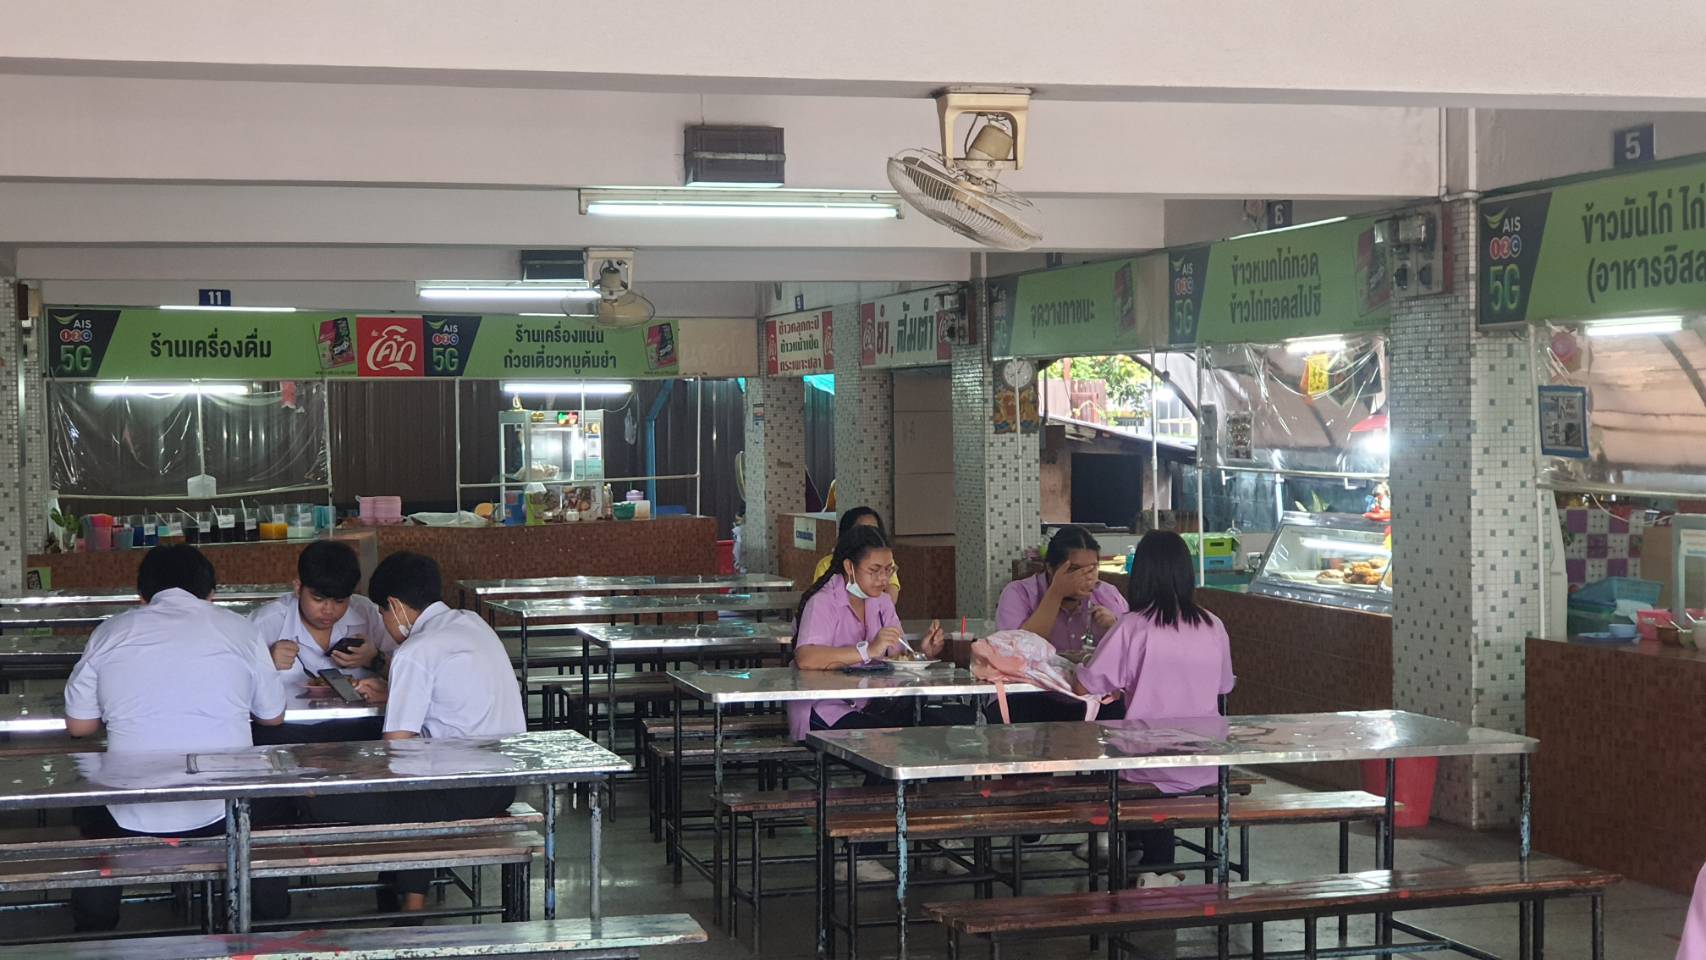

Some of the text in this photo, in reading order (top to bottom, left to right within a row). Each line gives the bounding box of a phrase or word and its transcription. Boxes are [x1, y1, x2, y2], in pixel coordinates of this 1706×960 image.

[1624, 131, 1641, 160] 5
[1274, 204, 1284, 225] 6
[1502, 216, 1521, 233] AIS
[1581, 188, 1673, 244] ข้าวมันไก่
[1182, 262, 1193, 275] AIS
[1231, 245, 1319, 287] ข้าวหมกไก่ทอด
[208, 291, 223, 305] 11
[1489, 263, 1521, 312] 5G
[73, 319, 92, 329] AIS
[442, 324, 458, 333] AIS
[778, 314, 820, 336] ข้าวคลุกกะปิ
[1174, 298, 1193, 335] 5G
[149, 327, 272, 358] ร้านเครื่องดื่ม
[515, 320, 604, 344] ร้านเครื่องแน่น
[780, 333, 819, 353] ข้าวหน้าเป็ด
[60, 344, 93, 372] 5G
[432, 347, 460, 372] 5G
[503, 344, 617, 374] ก๋วยเตี๋ยวหมูต้มยำ
